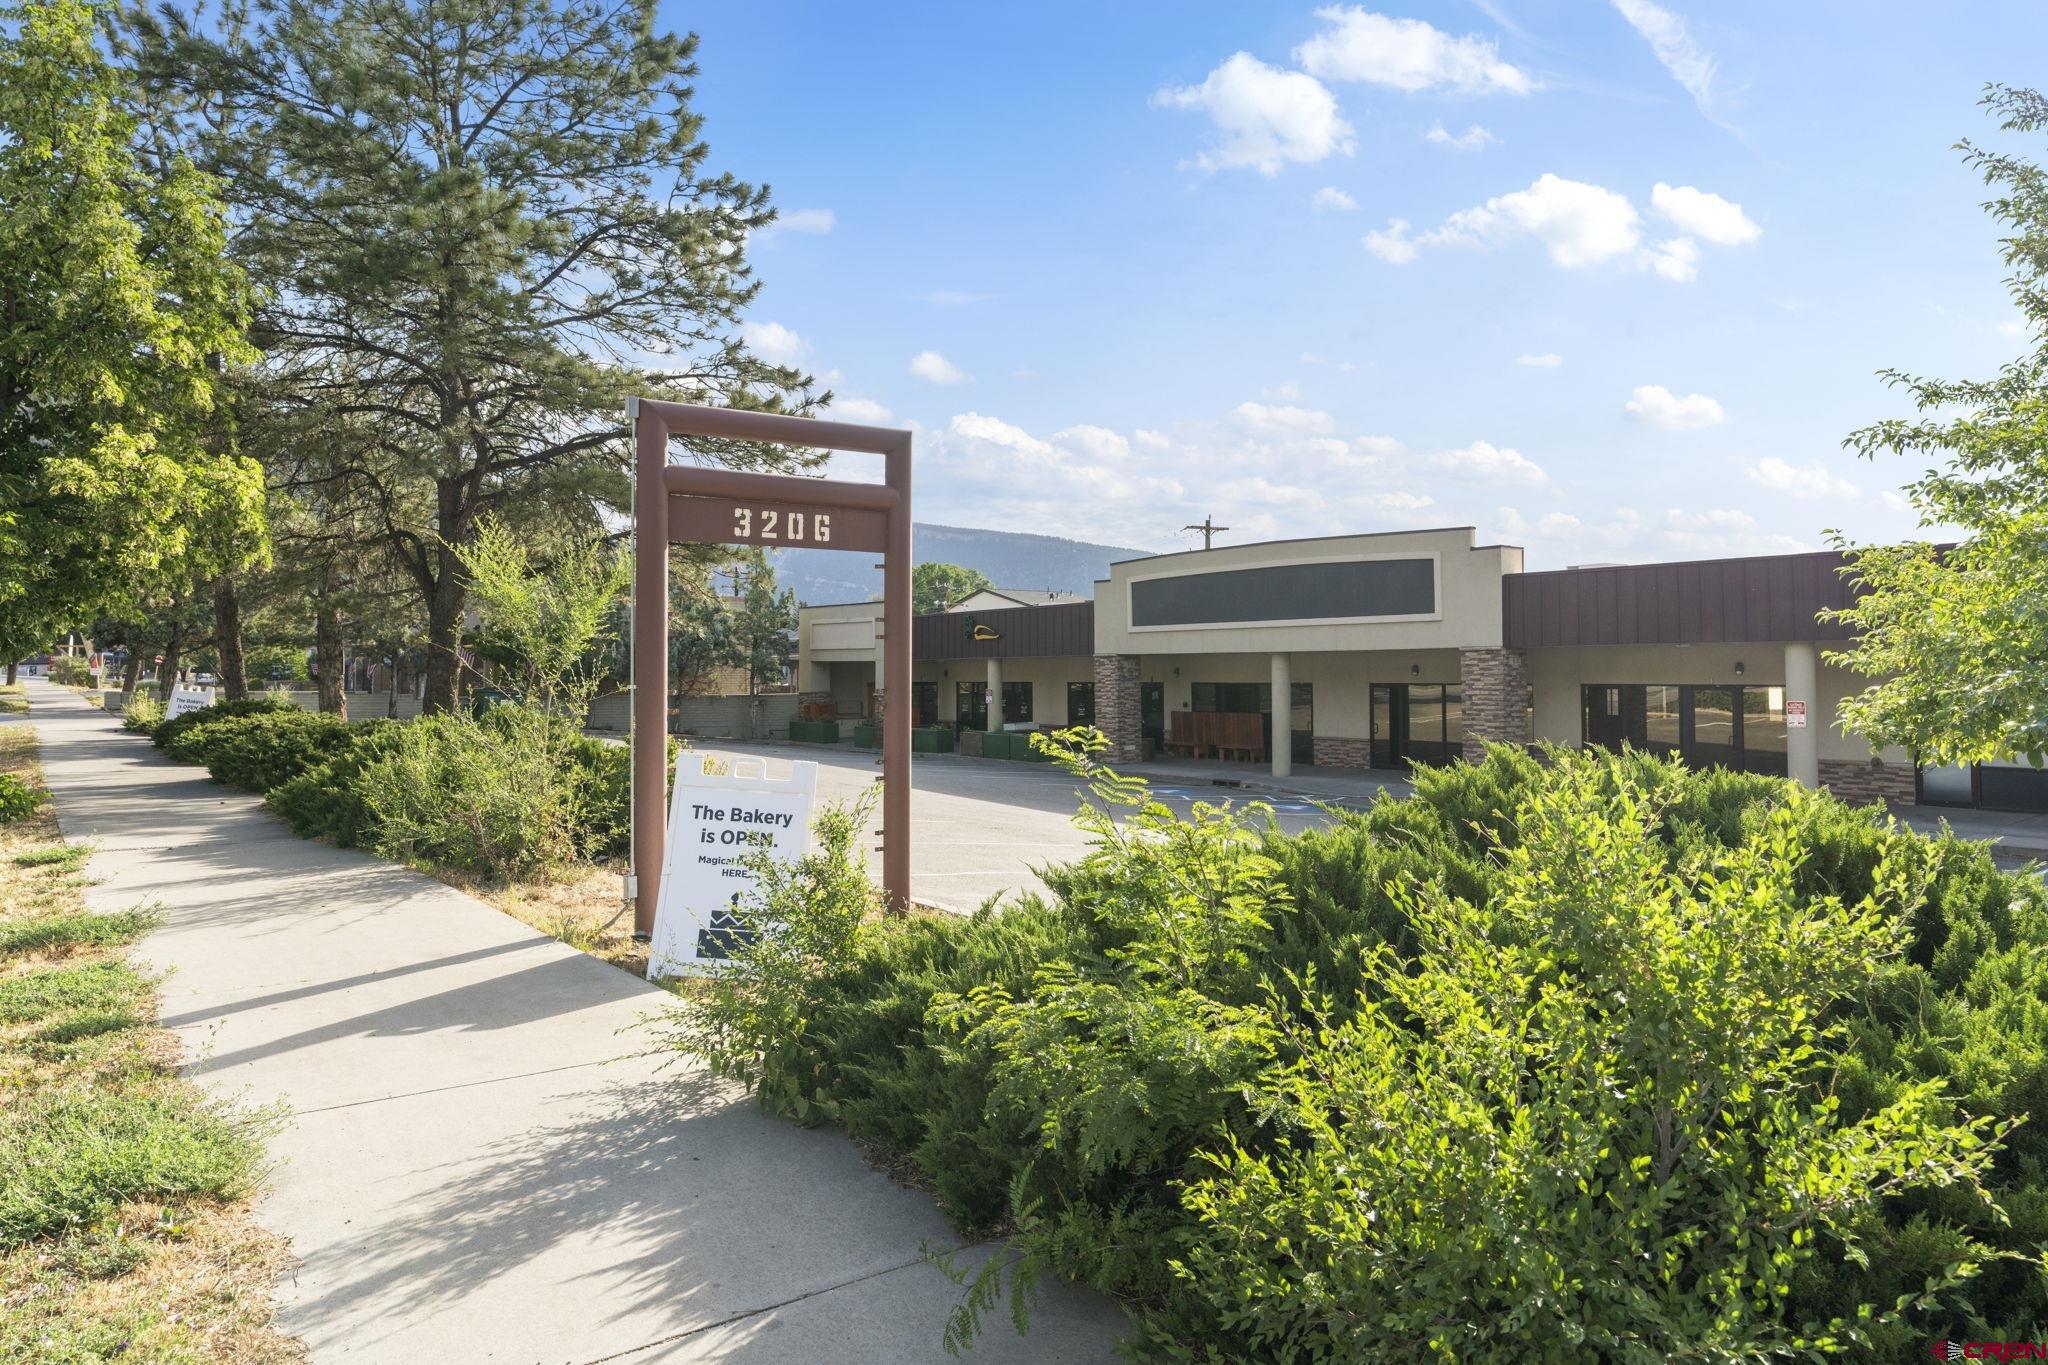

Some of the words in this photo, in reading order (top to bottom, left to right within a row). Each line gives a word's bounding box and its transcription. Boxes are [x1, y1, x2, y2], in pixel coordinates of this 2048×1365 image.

[733, 507, 830, 542] 3206
[692, 804, 725, 821] The
[730, 807, 793, 828] Bakery
[700, 828, 716, 844] is
[721, 868, 748, 879] HERE
